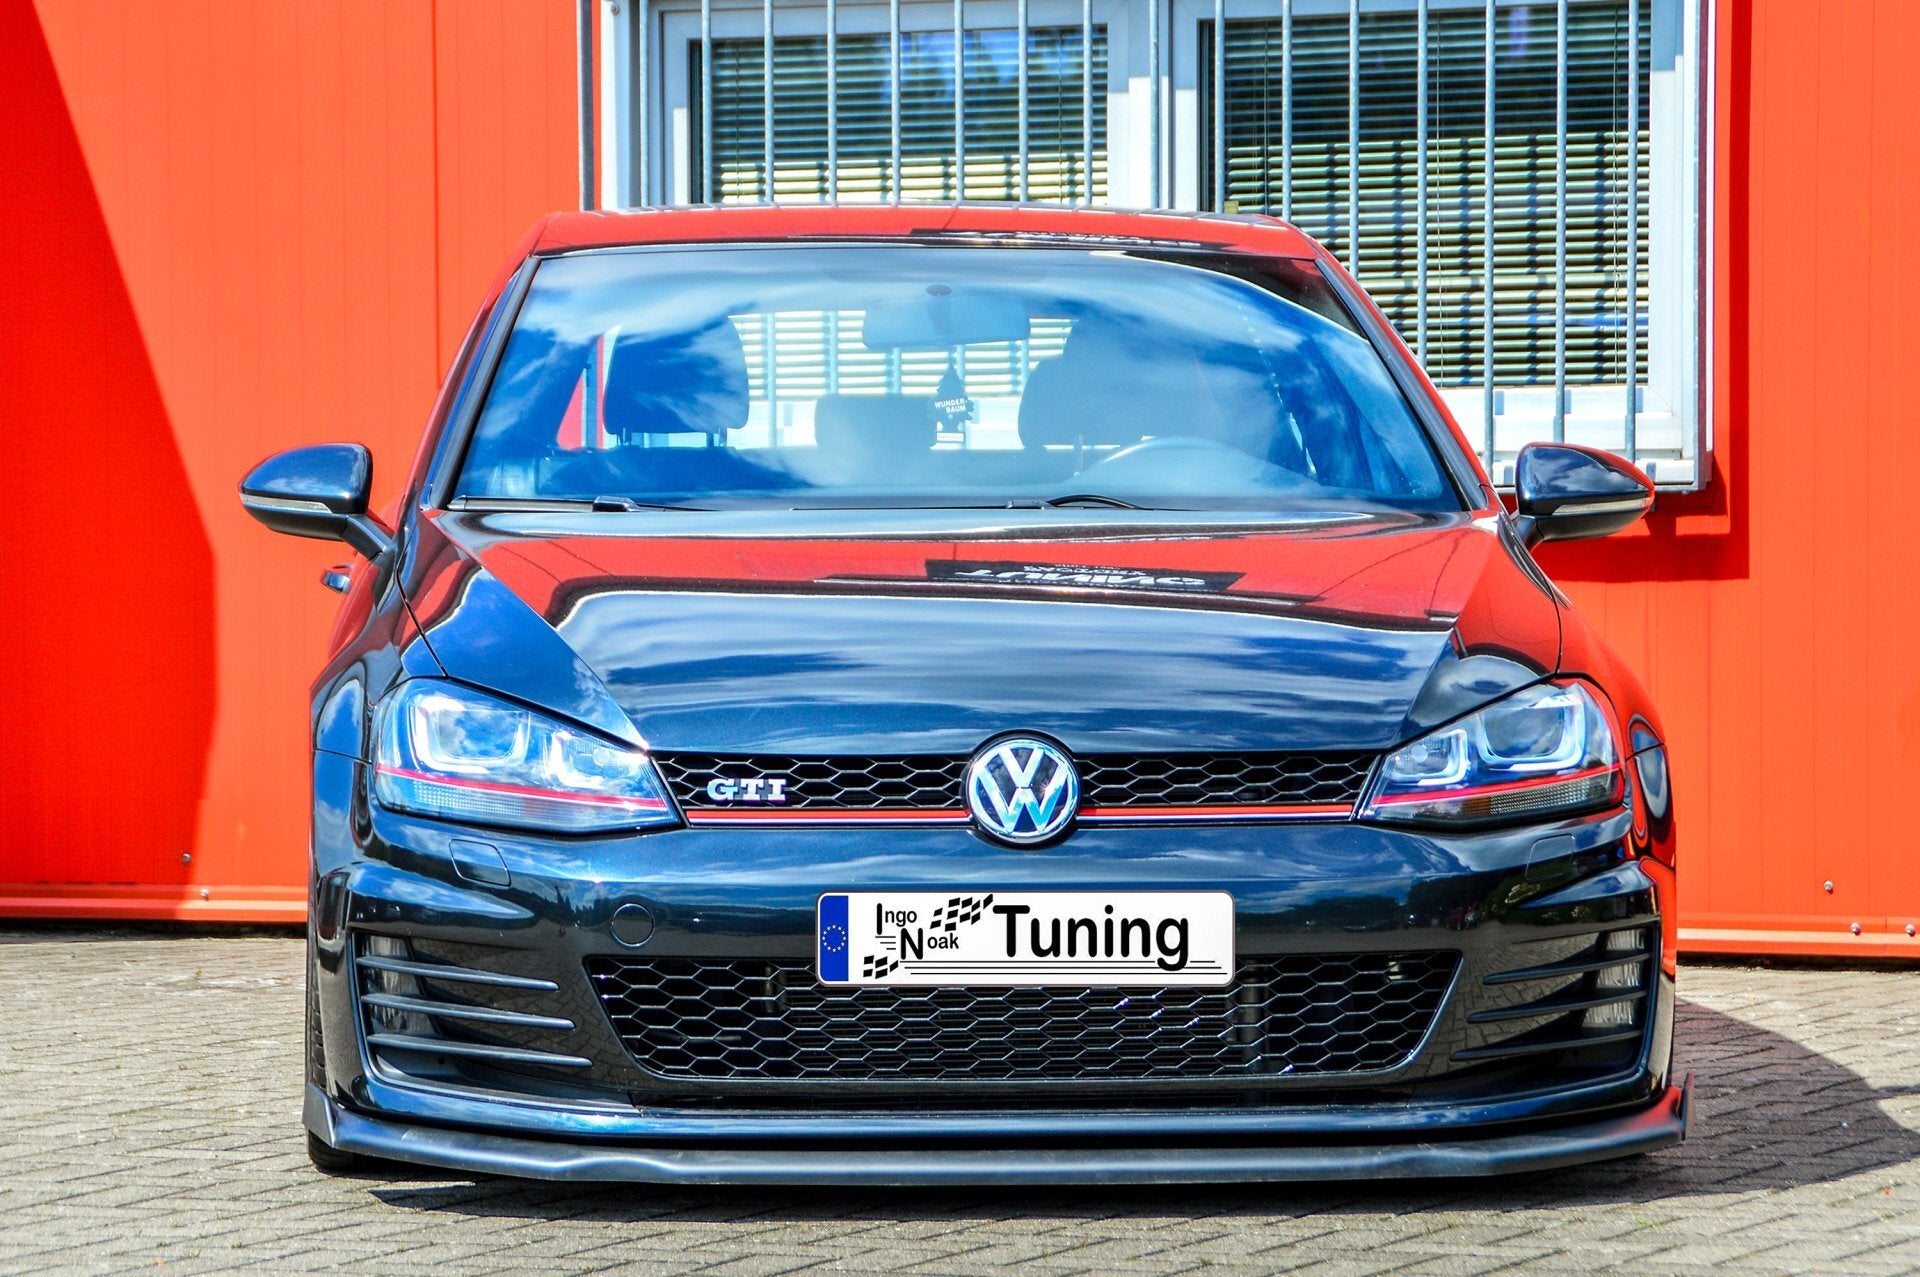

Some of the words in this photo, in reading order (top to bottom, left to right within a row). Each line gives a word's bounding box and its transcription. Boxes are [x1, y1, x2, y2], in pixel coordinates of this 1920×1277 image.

[934, 398, 968, 408] WUNDER-
[945, 405, 967, 413] BAUM
[706, 777, 788, 803] GTI
[876, 903, 917, 935] Ingo
[900, 928, 960, 960] Noak
[992, 904, 1189, 971] Tuning
